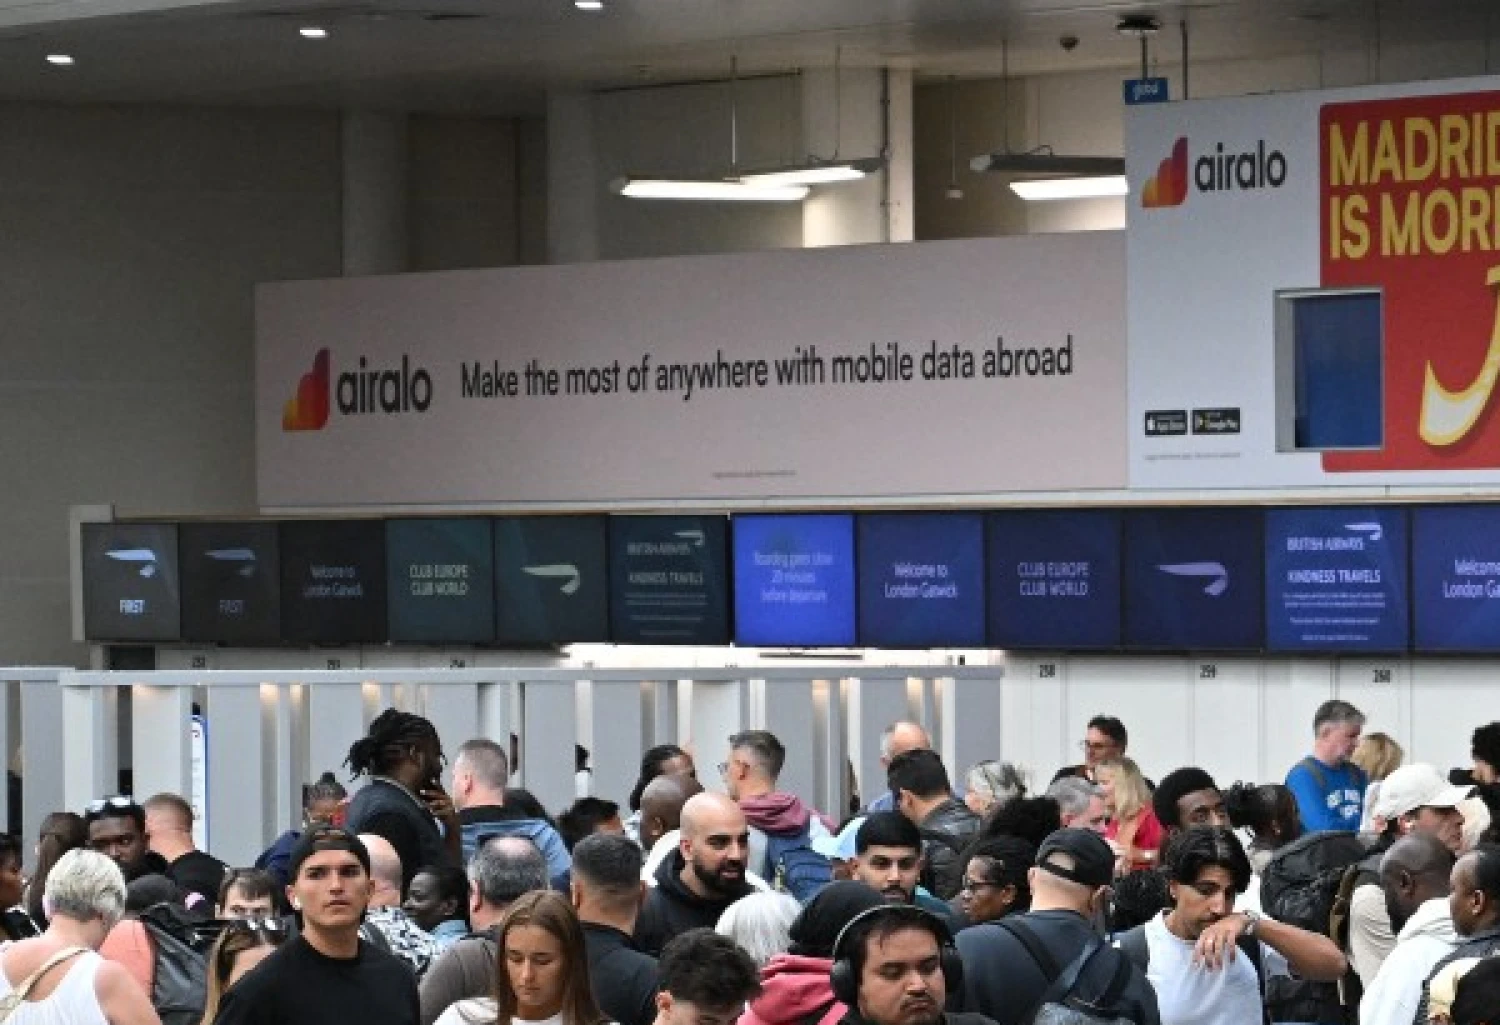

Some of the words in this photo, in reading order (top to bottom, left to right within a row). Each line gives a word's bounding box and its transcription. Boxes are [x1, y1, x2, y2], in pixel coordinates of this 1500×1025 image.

[1194, 140, 1288, 193] airalo
[1329, 193, 1370, 260] IS
[460, 358, 518, 399] Make
[524, 356, 560, 397] the
[566, 360, 620, 396] most
[627, 354, 651, 393] of
[655, 350, 769, 401] anywhere
[775, 345, 825, 386] with
[832, 341, 913, 385] mobile
[920, 338, 976, 380] data
[981, 334, 1074, 377] abroad
[337, 354, 431, 415] airalo
[893, 562, 933, 578] Welcome
[1017, 562, 1044, 577] CLUB
[1046, 562, 1090, 577] EUROPE
[1454, 559, 1500, 576] Welcome
[1287, 570, 1335, 583] KINDNESS
[1339, 570, 1380, 583] TRAVELS
[884, 582, 918, 598] London
[1019, 580, 1046, 596] CLUB
[1050, 580, 1088, 596] WORLD
[1443, 580, 1483, 598] London
